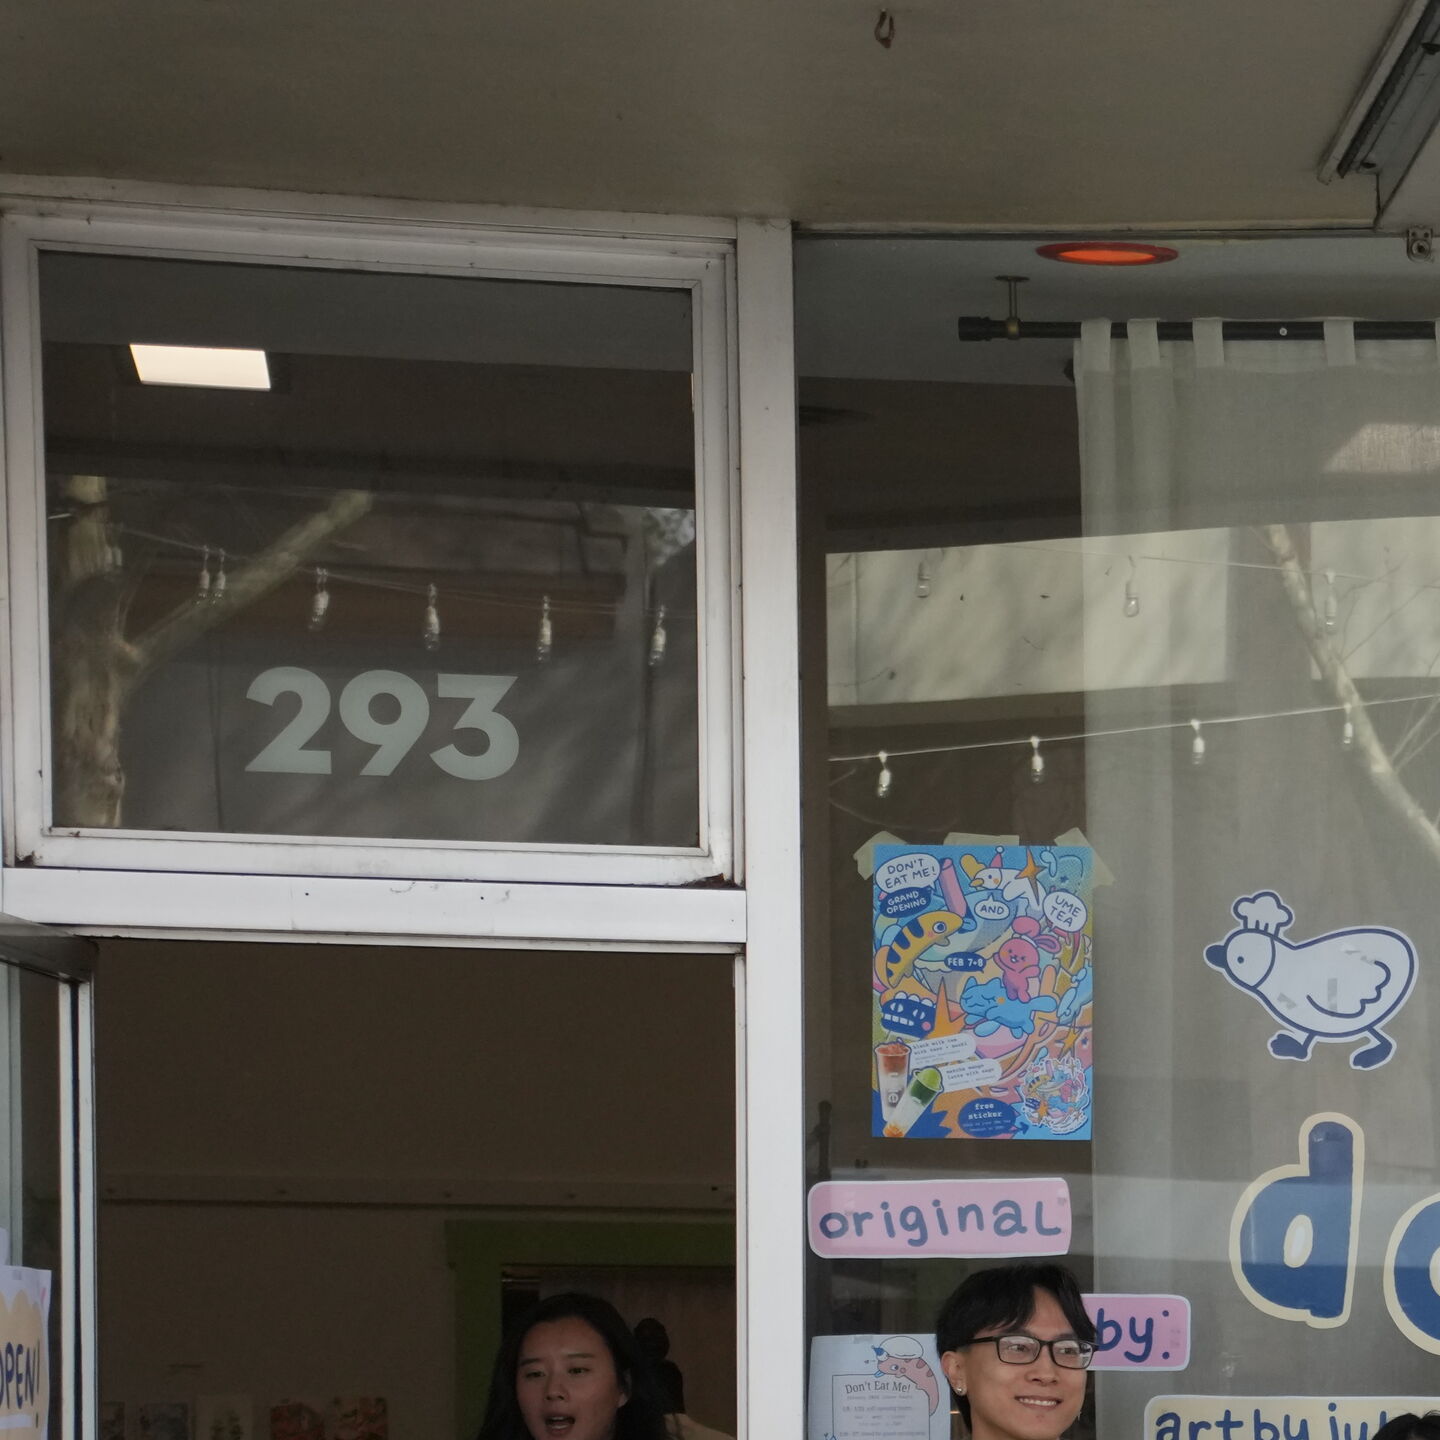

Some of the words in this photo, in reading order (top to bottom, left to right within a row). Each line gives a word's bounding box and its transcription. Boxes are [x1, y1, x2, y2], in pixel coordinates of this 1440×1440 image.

[245, 666, 519, 781] 293
[887, 858, 924, 875] DON'T
[885, 874, 908, 889] EAT
[912, 866, 937, 880] ME!
[886, 898, 927, 914] OPENING
[887, 891, 919, 906] GRAND
[1055, 895, 1082, 917] UME
[980, 904, 1005, 915] AND
[1050, 905, 1073, 928] TEA
[947, 957, 964, 967] FEB
[968, 1111, 1003, 1120] sticker
[818, 1199, 1062, 1248] original
[1094, 1308, 1170, 1362] by:
[0, 1337, 40, 1429] PEN!
[845, 1381, 871, 1394] Don't
[874, 1380, 889, 1391] Eat
[892, 1381, 911, 1393] Me!
